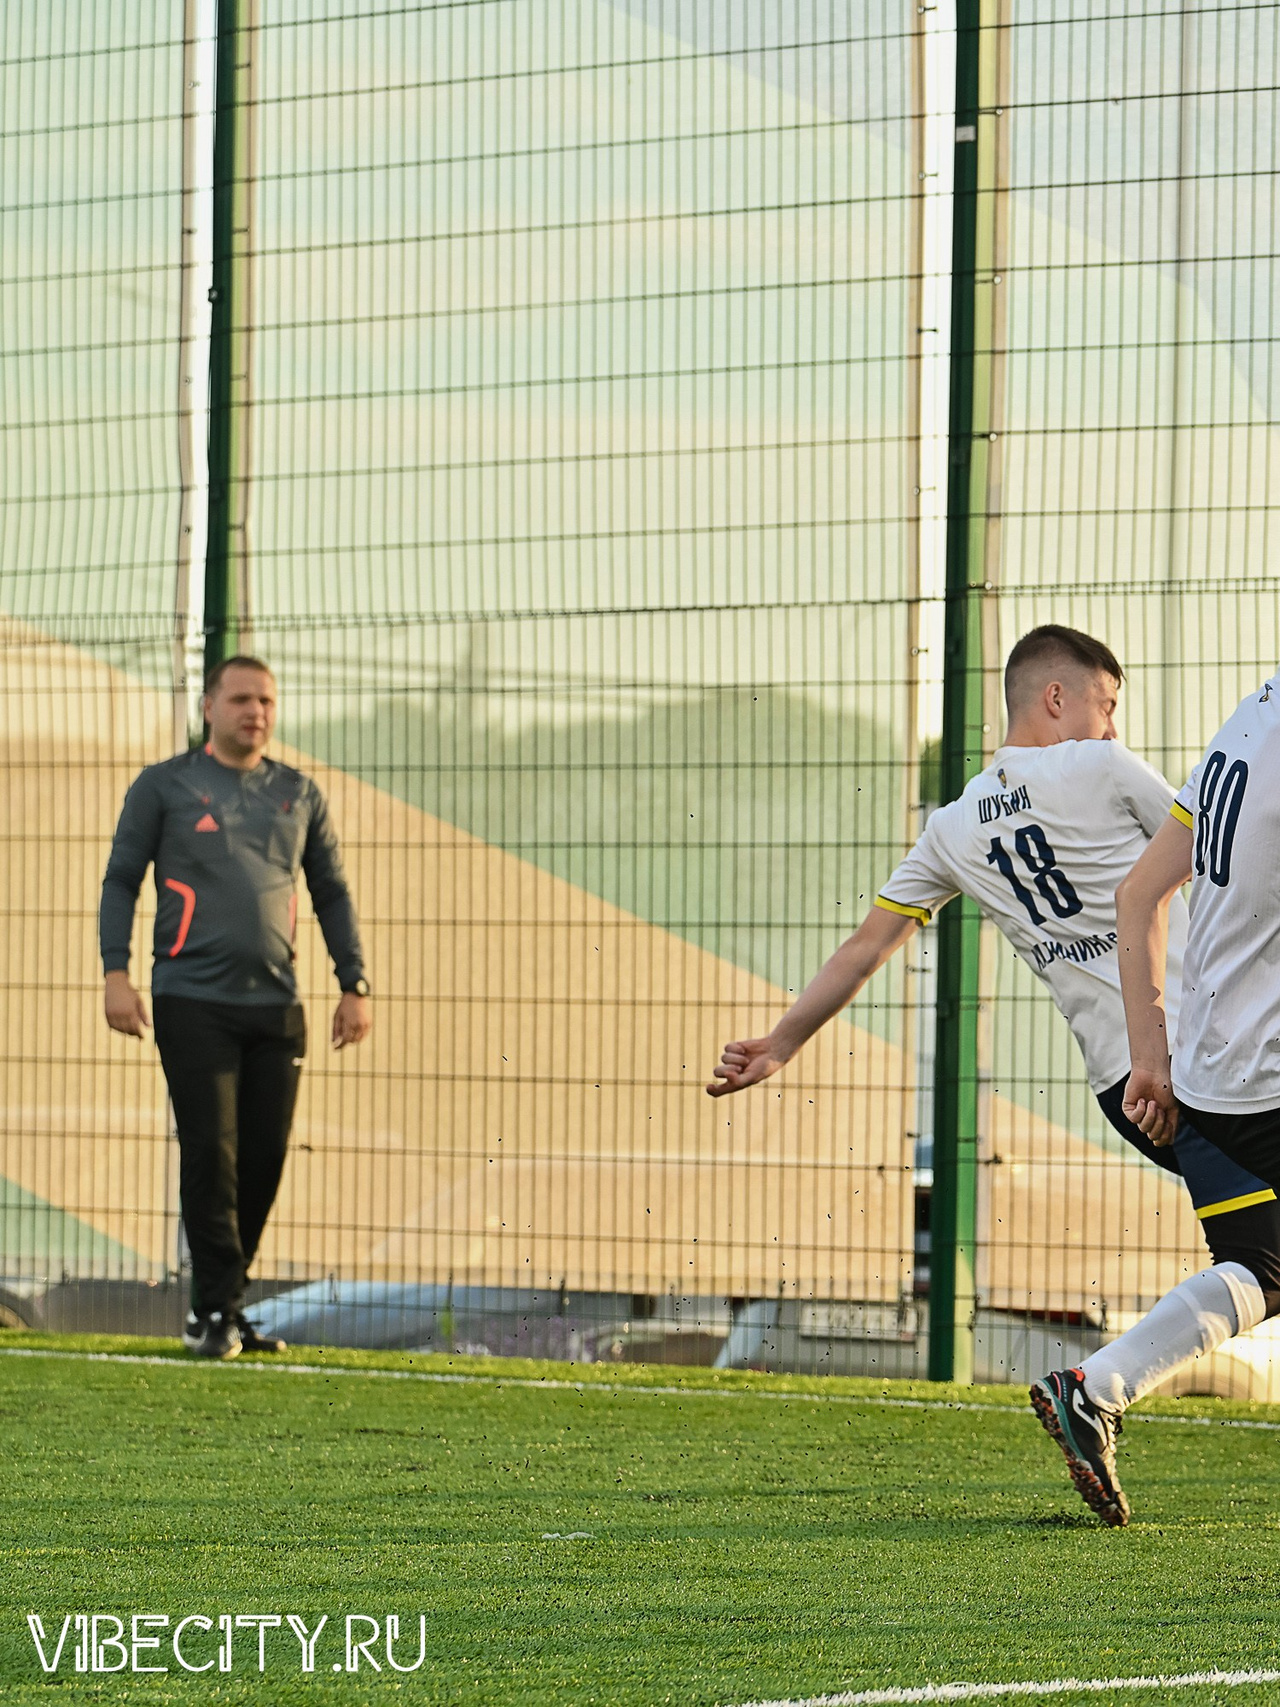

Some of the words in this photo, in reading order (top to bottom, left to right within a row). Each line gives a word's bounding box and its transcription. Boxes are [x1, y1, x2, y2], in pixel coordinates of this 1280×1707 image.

[978, 784, 1032, 824] ШУБИН
[1195, 750, 1249, 888] 80
[986, 823, 1084, 926] 18
